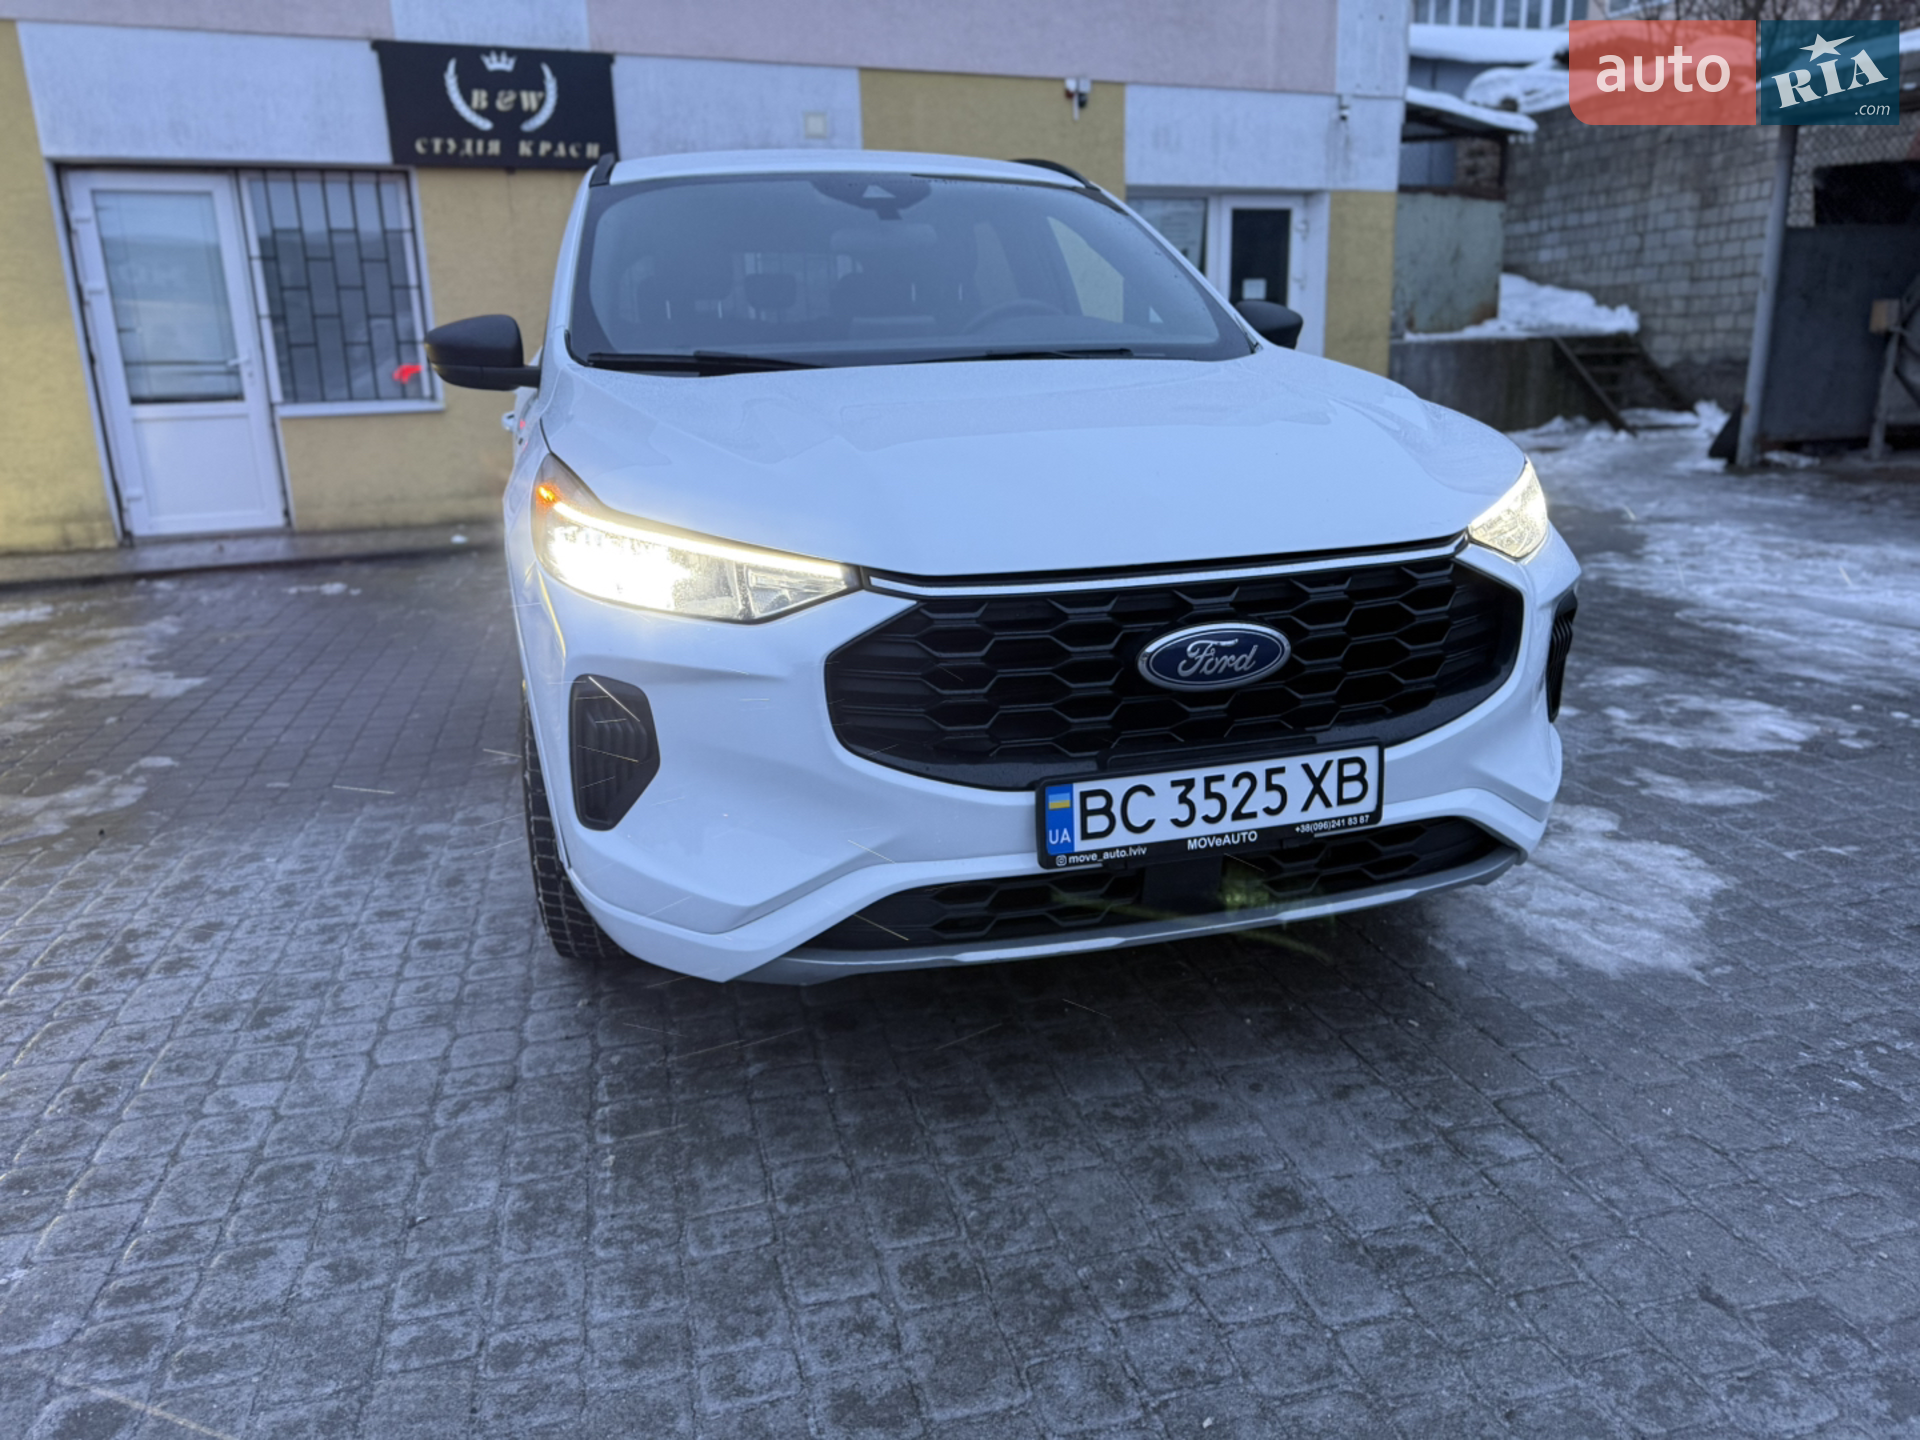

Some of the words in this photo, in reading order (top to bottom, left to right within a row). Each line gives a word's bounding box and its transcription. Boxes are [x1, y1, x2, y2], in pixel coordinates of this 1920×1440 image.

[415, 137, 501, 157] СТУДІЯ
[1177, 638, 1259, 677] Ford
[1079, 783, 1156, 841] BC
[1169, 766, 1288, 828] 3525
[1300, 756, 1369, 812] XB
[1048, 829, 1071, 845] UA
[1187, 830, 1258, 851] MOVeAUTO
[1068, 846, 1147, 864] move_auto.lviv
